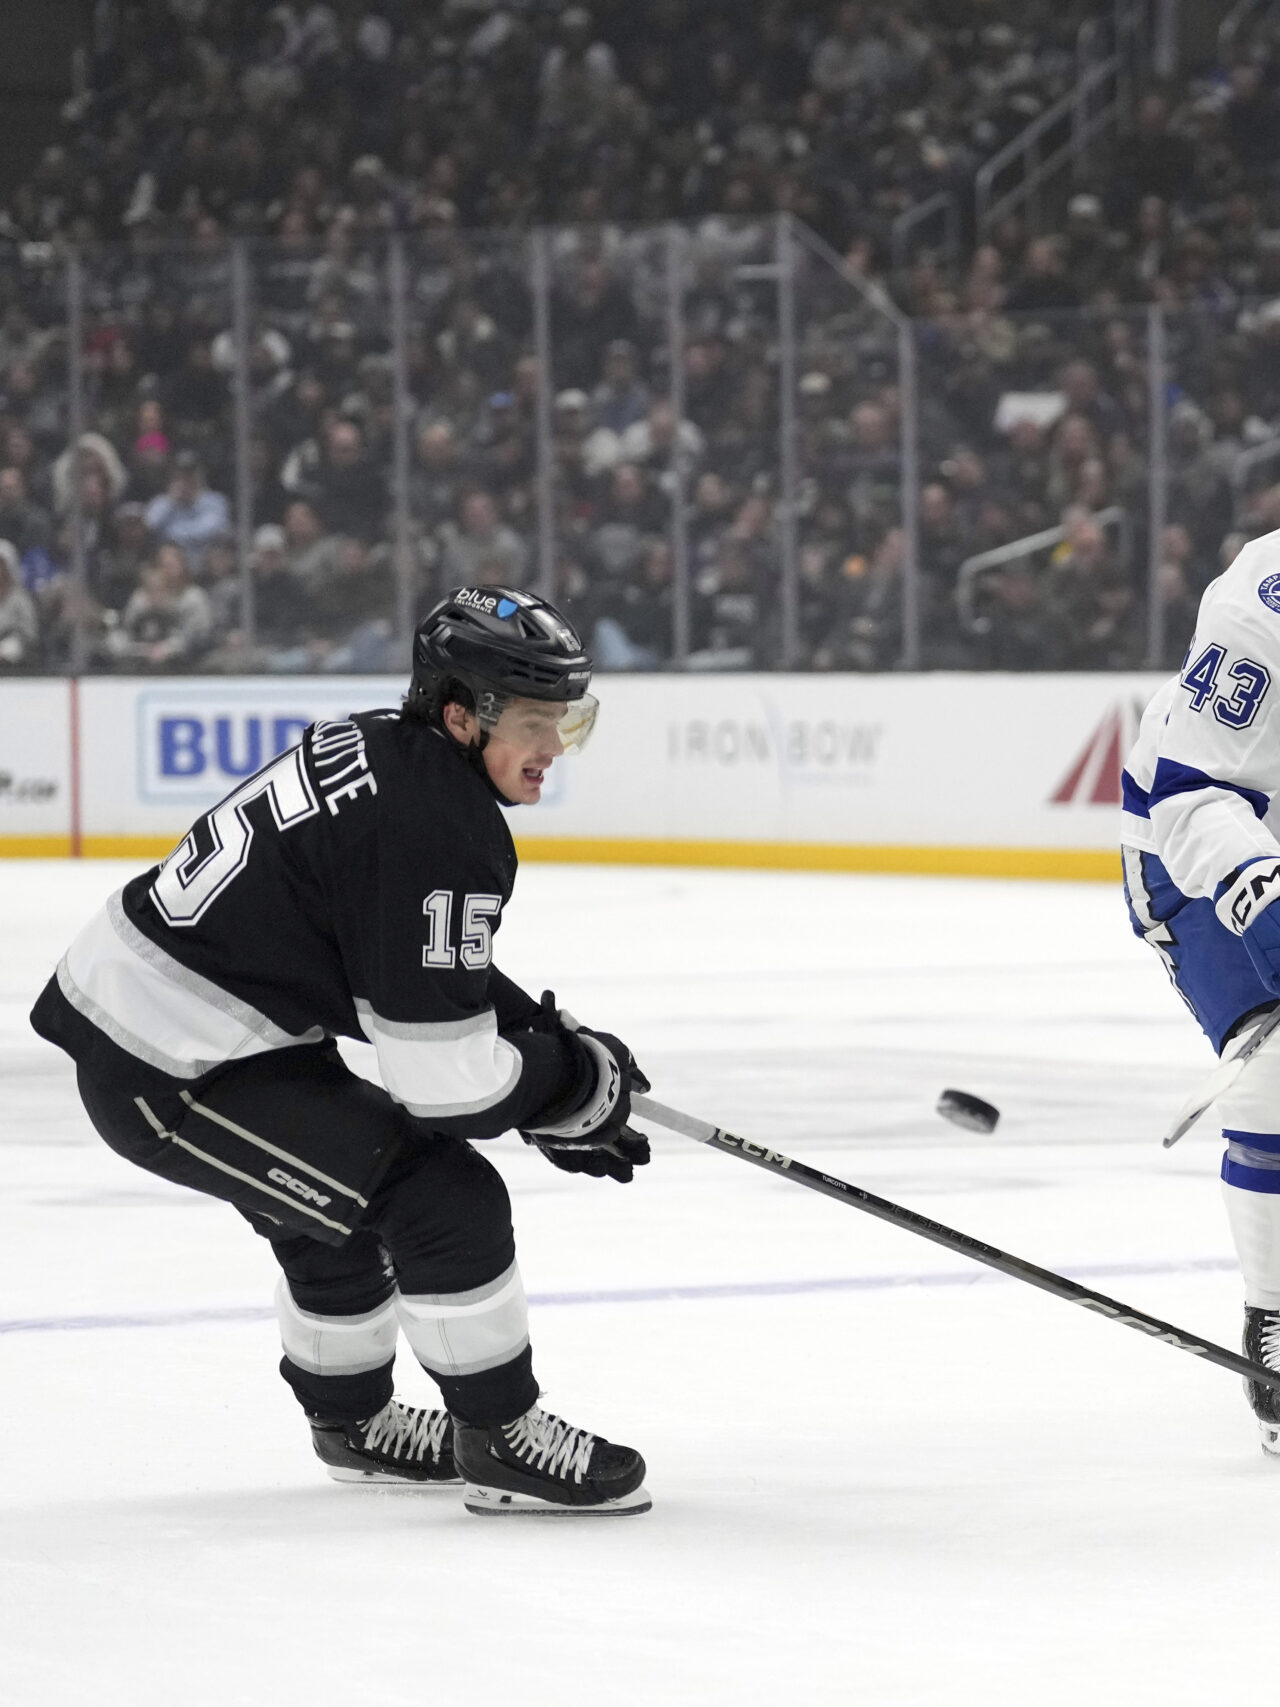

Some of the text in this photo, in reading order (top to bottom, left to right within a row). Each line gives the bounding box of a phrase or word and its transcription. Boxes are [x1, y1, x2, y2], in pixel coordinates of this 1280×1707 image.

[453, 598, 492, 614] CALIFORNIA
[456, 587, 497, 609] blue
[1180, 642, 1272, 731] 43
[667, 720, 886, 766] IRON BOW
[311, 720, 377, 816] COTTE
[150, 744, 320, 927] 5
[422, 889, 502, 970] 15
[717, 1128, 793, 1169] CCM
[267, 1167, 332, 1208] CCM
[822, 1174, 848, 1191] TURCOTTE
